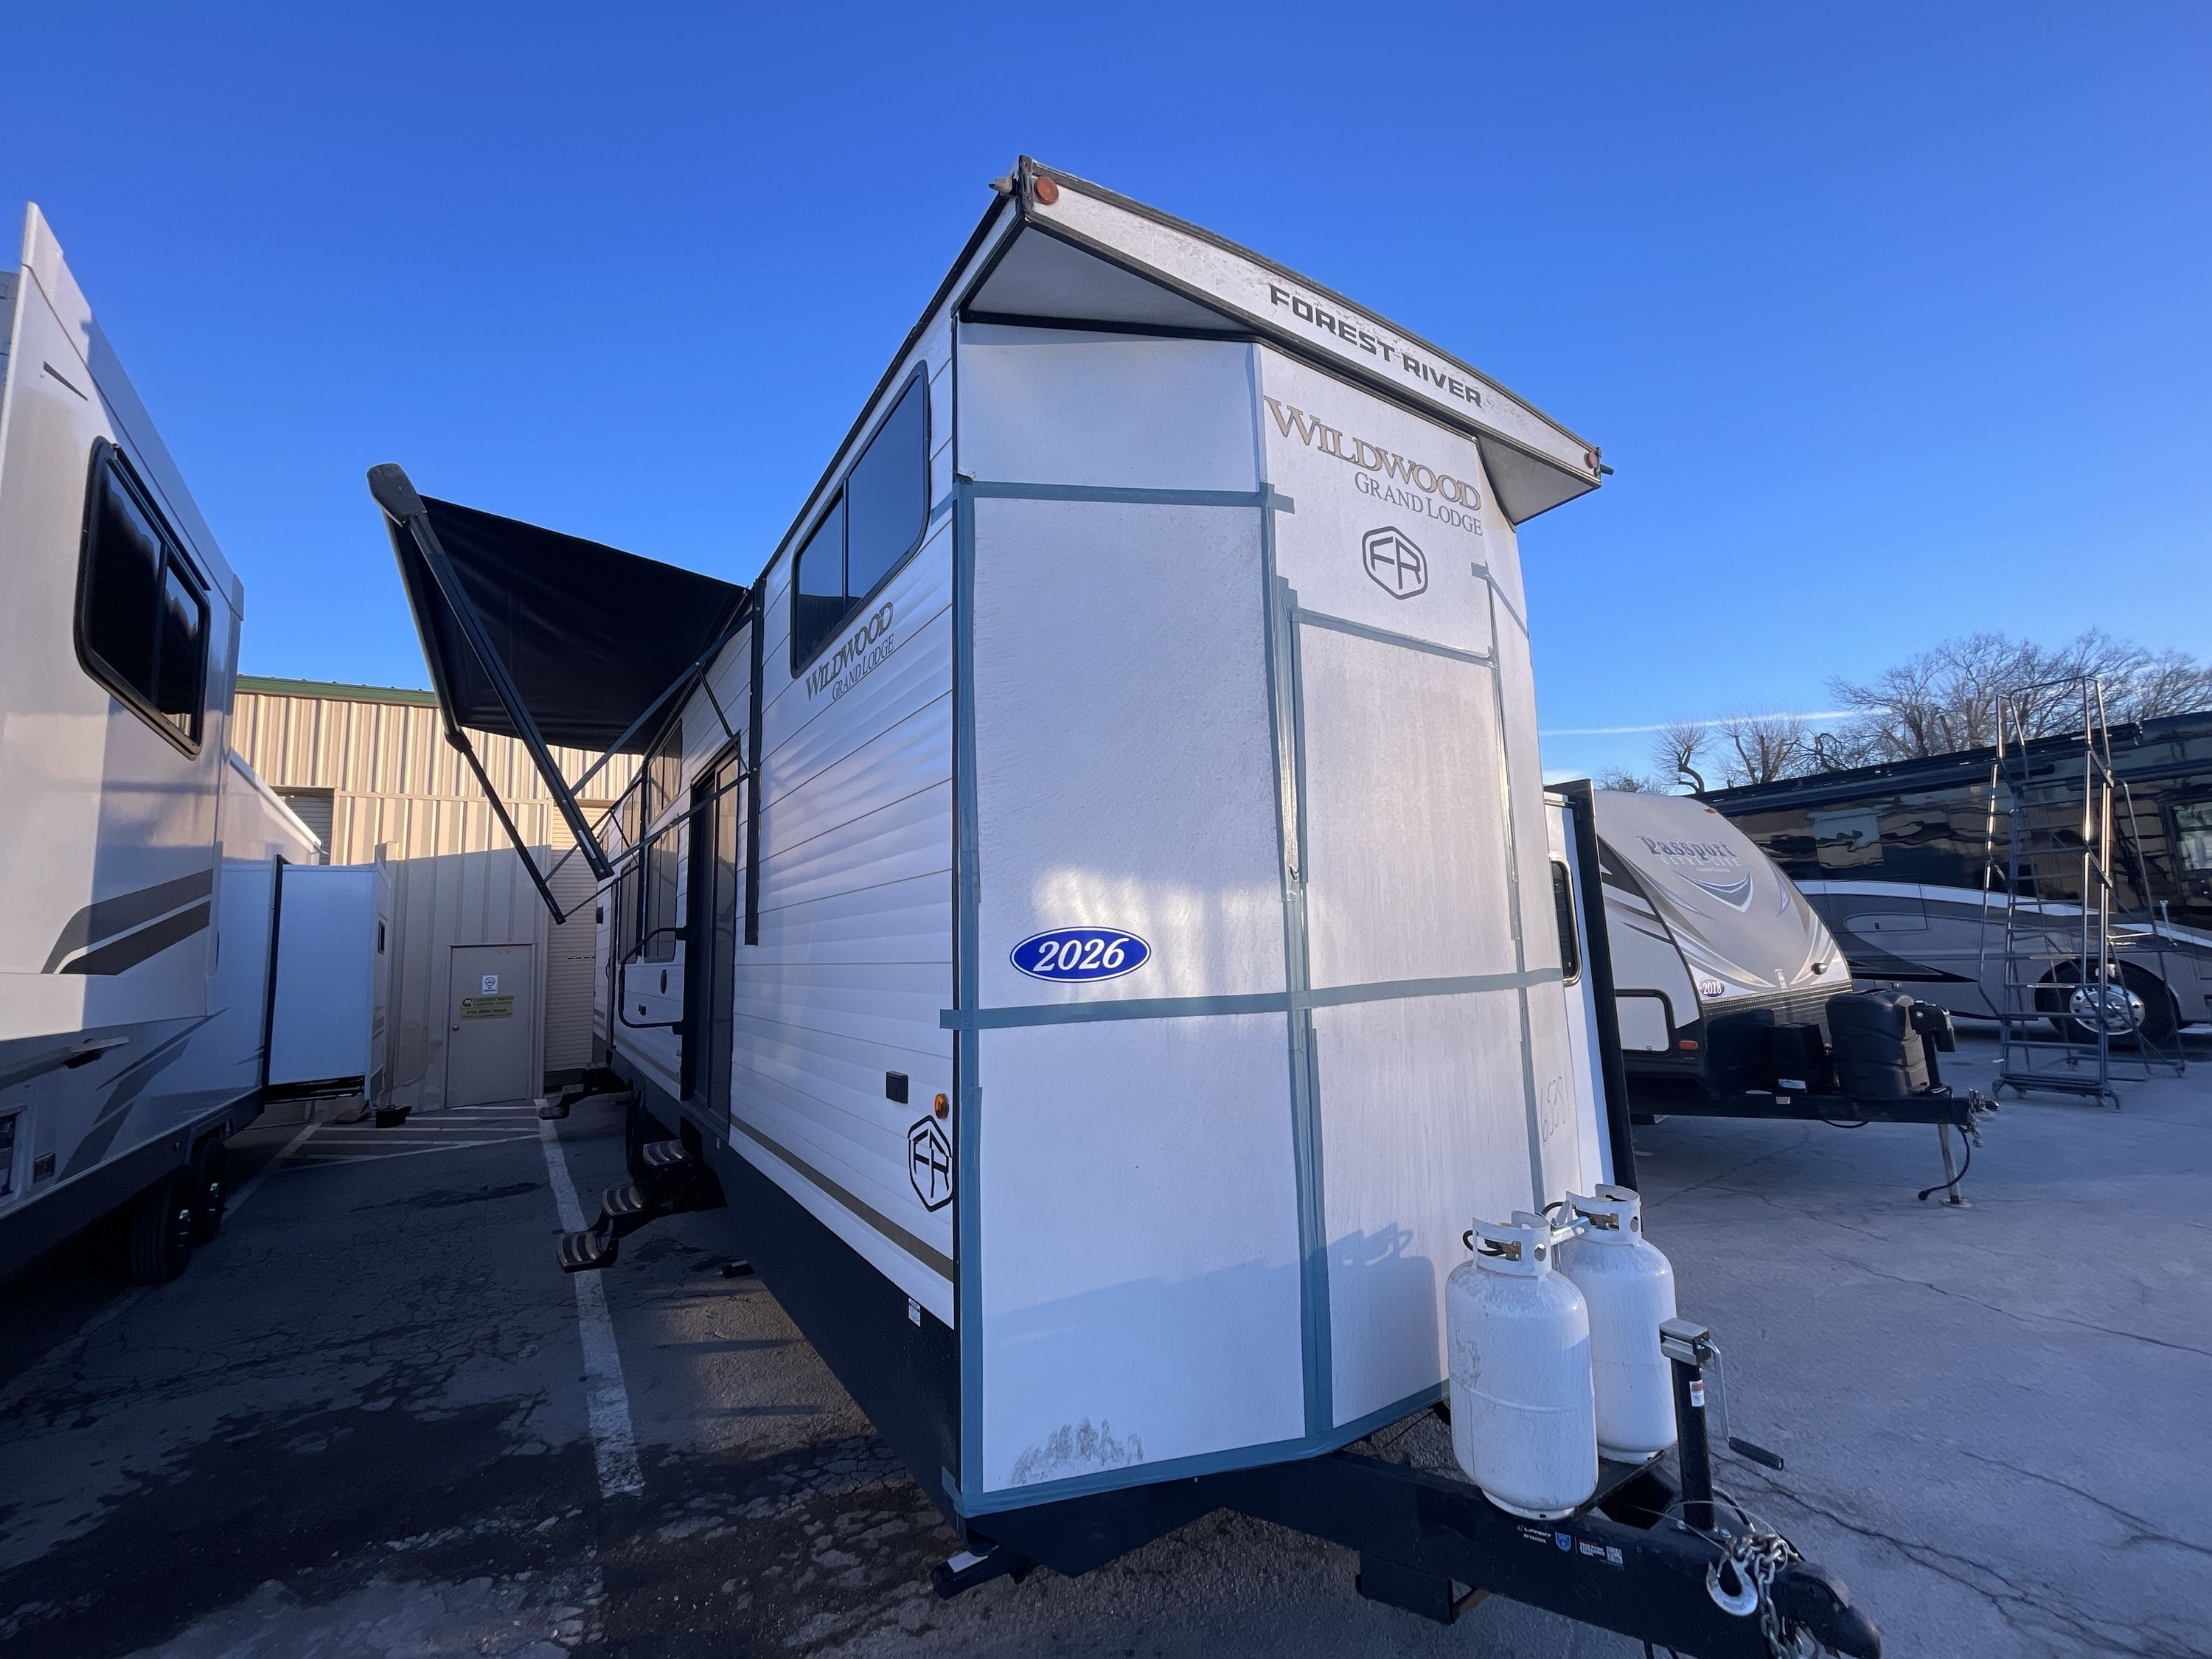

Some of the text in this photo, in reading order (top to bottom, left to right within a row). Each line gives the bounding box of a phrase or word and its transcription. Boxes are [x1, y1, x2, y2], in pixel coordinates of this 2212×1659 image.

[1268, 282, 1483, 408] FOREST RIVER
[1263, 395, 1482, 511] WILDWOOD
[1354, 471, 1483, 536] GRAND LODGE
[805, 601, 894, 701] WILDWOOD
[832, 633, 894, 700] GRAND LODGE
[1032, 937, 1130, 972] 2026
[1703, 981, 1722, 995] 2018
